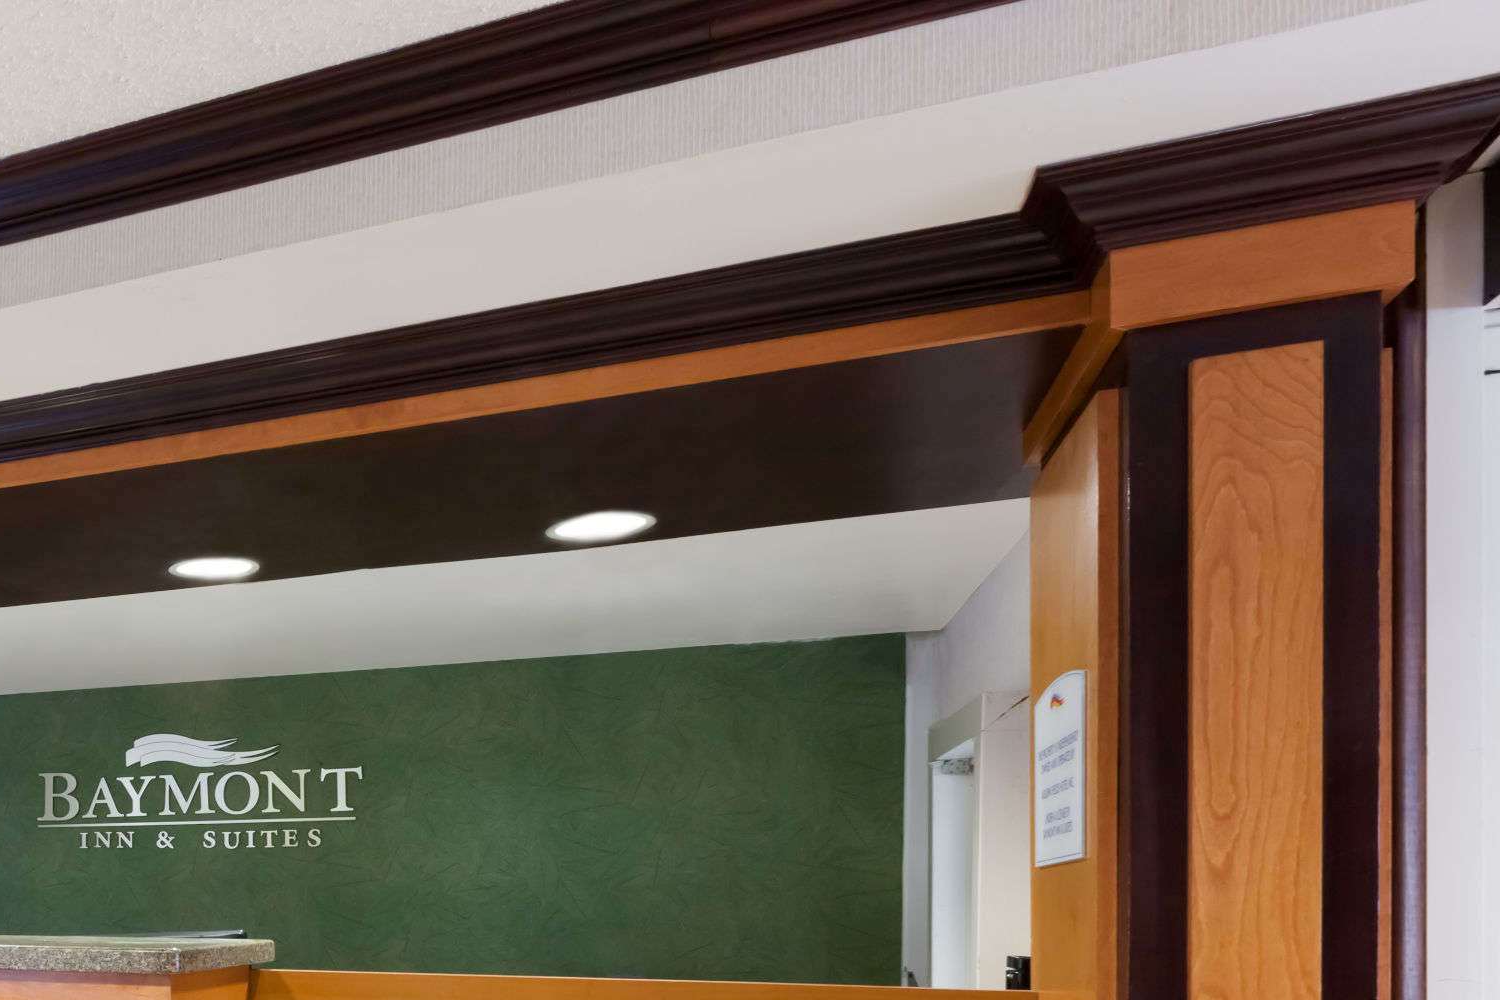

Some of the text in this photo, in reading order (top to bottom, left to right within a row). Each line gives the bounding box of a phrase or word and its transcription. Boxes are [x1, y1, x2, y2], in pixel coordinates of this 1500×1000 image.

[36, 766, 363, 822] BAYMONT
[79, 829, 323, 849] INN & SUITES
